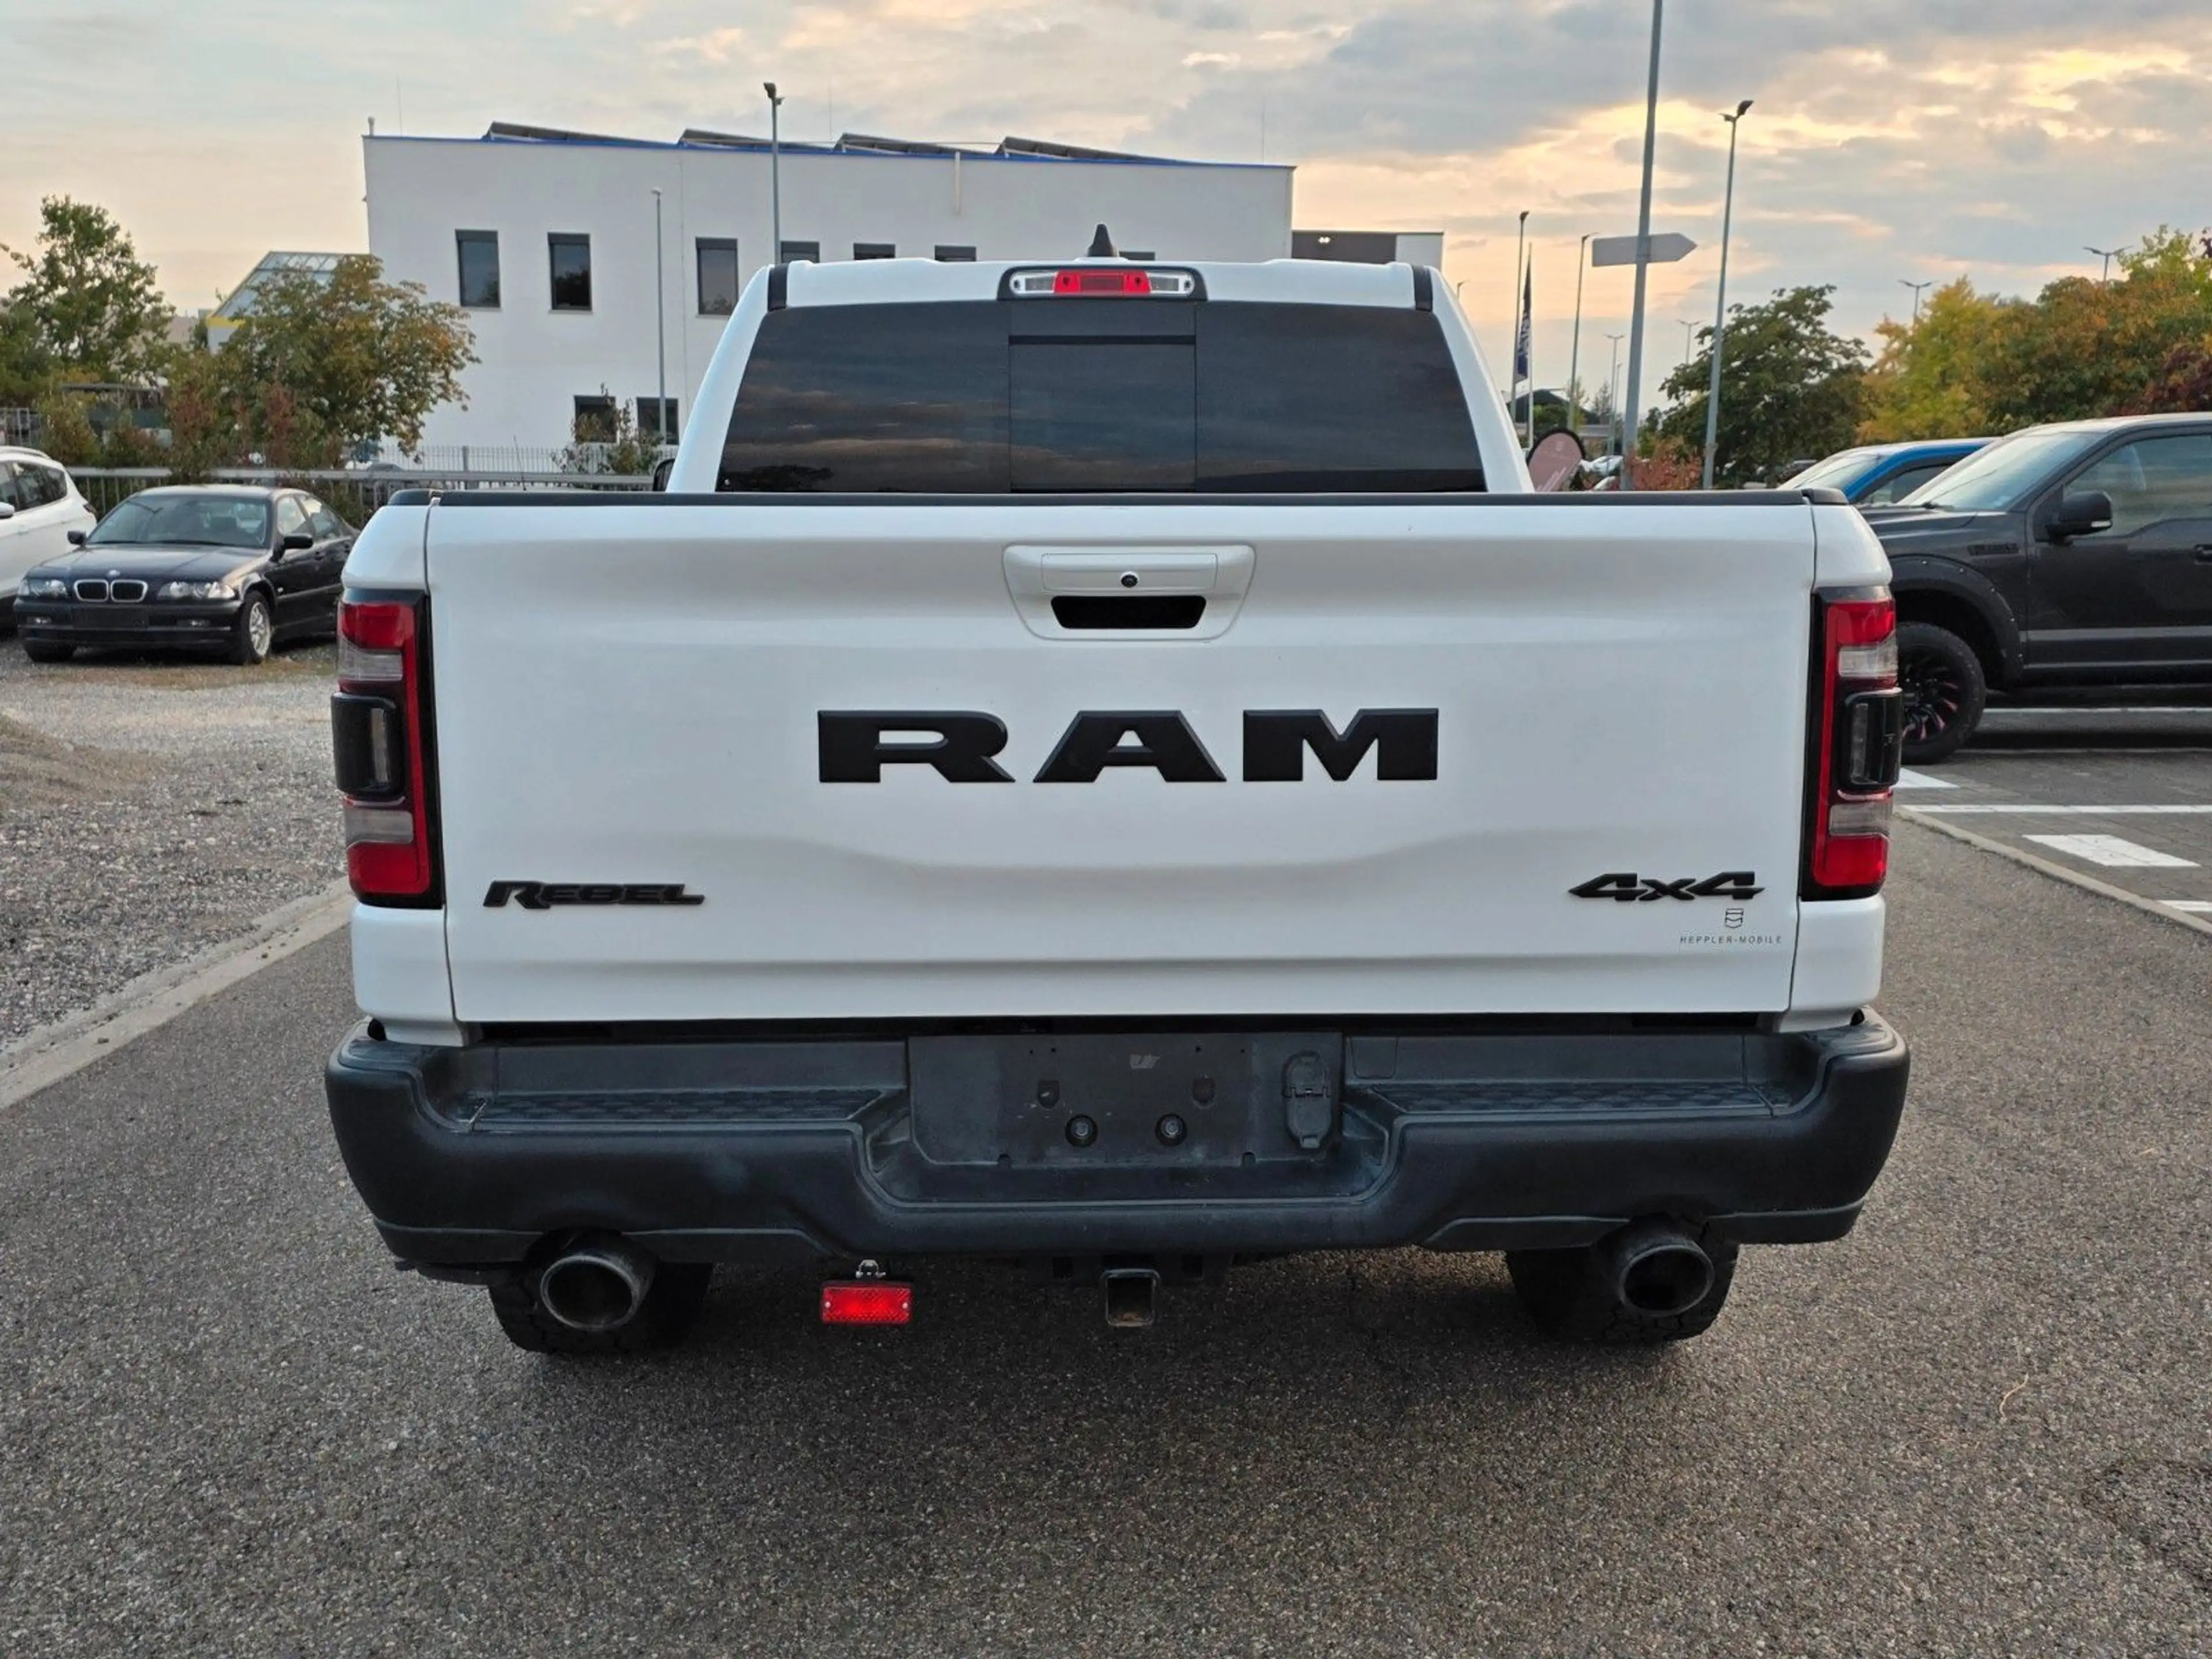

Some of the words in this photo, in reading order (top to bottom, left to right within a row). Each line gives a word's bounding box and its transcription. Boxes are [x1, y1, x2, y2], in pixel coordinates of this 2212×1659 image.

[818, 709, 1439, 783] RAM
[483, 880, 705, 910] REBEL
[1568, 871, 1765, 903] 4x4
